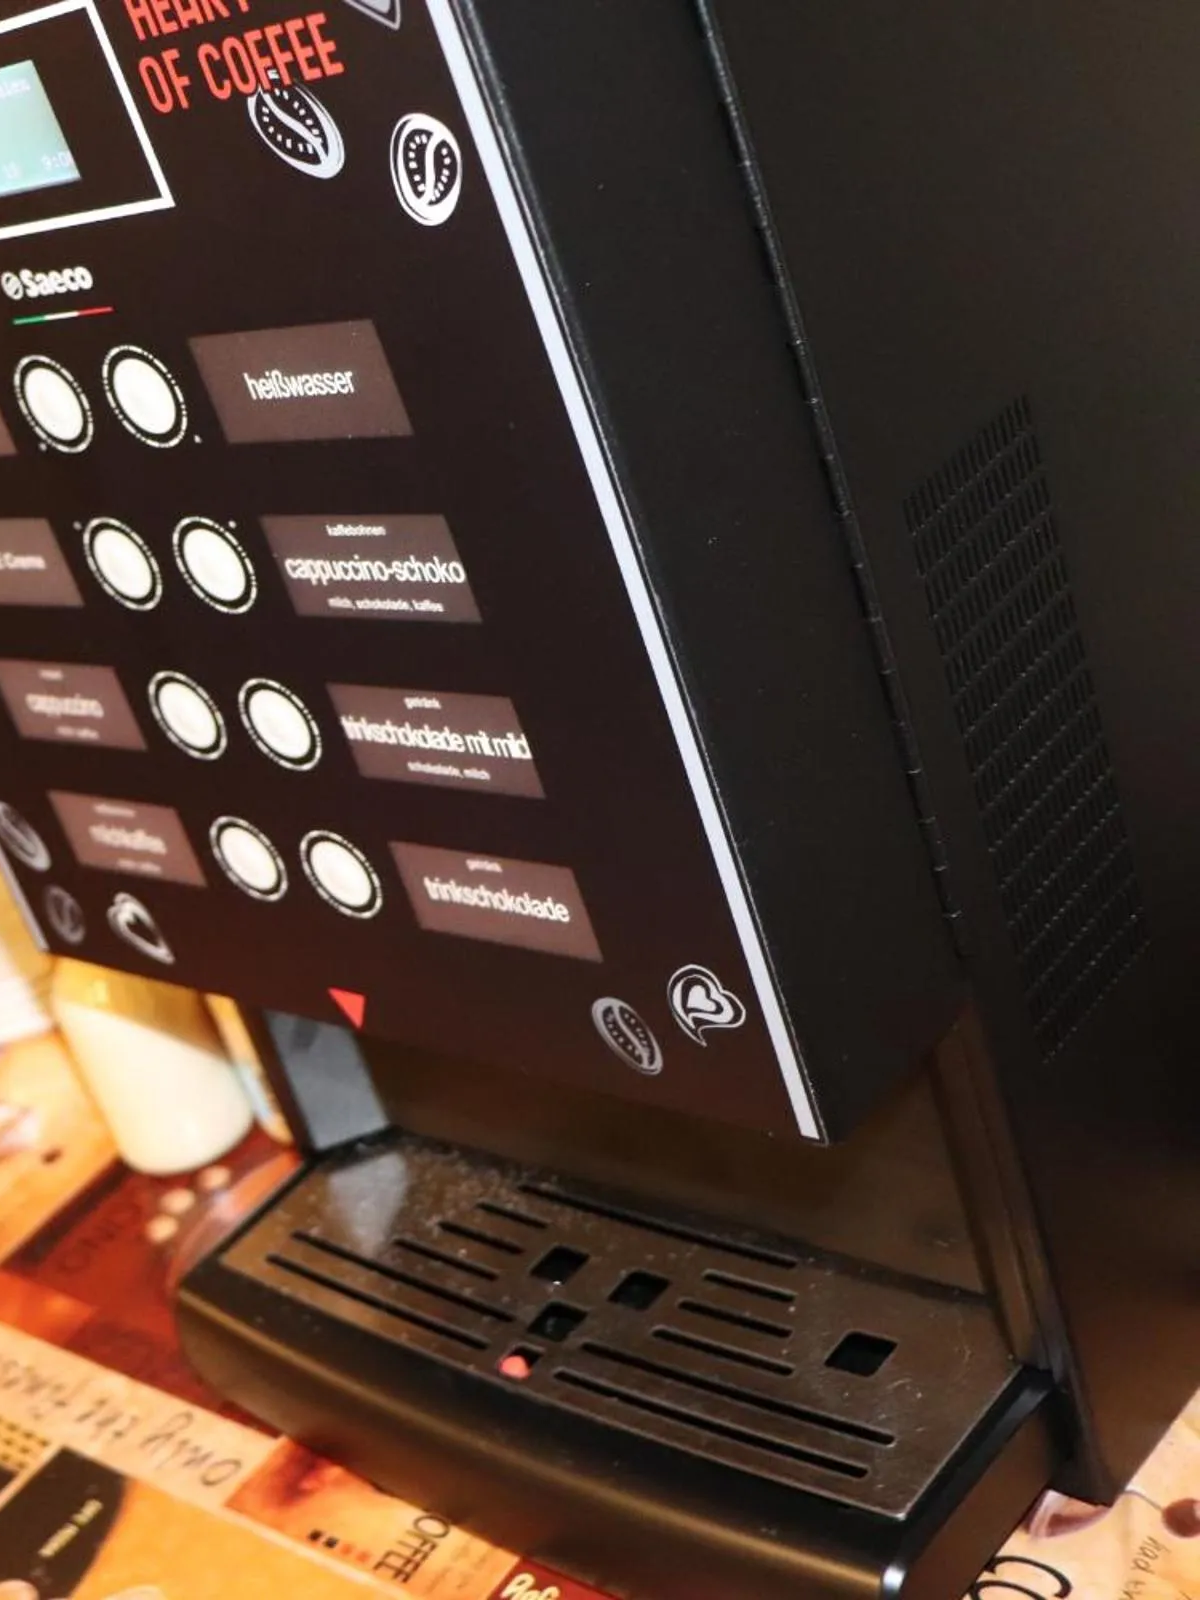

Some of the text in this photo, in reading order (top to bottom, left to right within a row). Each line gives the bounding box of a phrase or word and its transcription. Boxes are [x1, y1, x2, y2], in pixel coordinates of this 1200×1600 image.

[138, 12, 345, 115] OF COFFEE
[20, 265, 94, 298] Saeco
[243, 369, 355, 400] heißwasser
[284, 553, 467, 586] cappuccino-schoko
[341, 714, 466, 753] trinkschokolade
[465, 730, 494, 757] mit
[423, 876, 571, 923] trinkschokolade
[138, 1410, 243, 1487] Only
[372, 1511, 452, 1584] OFFEE
